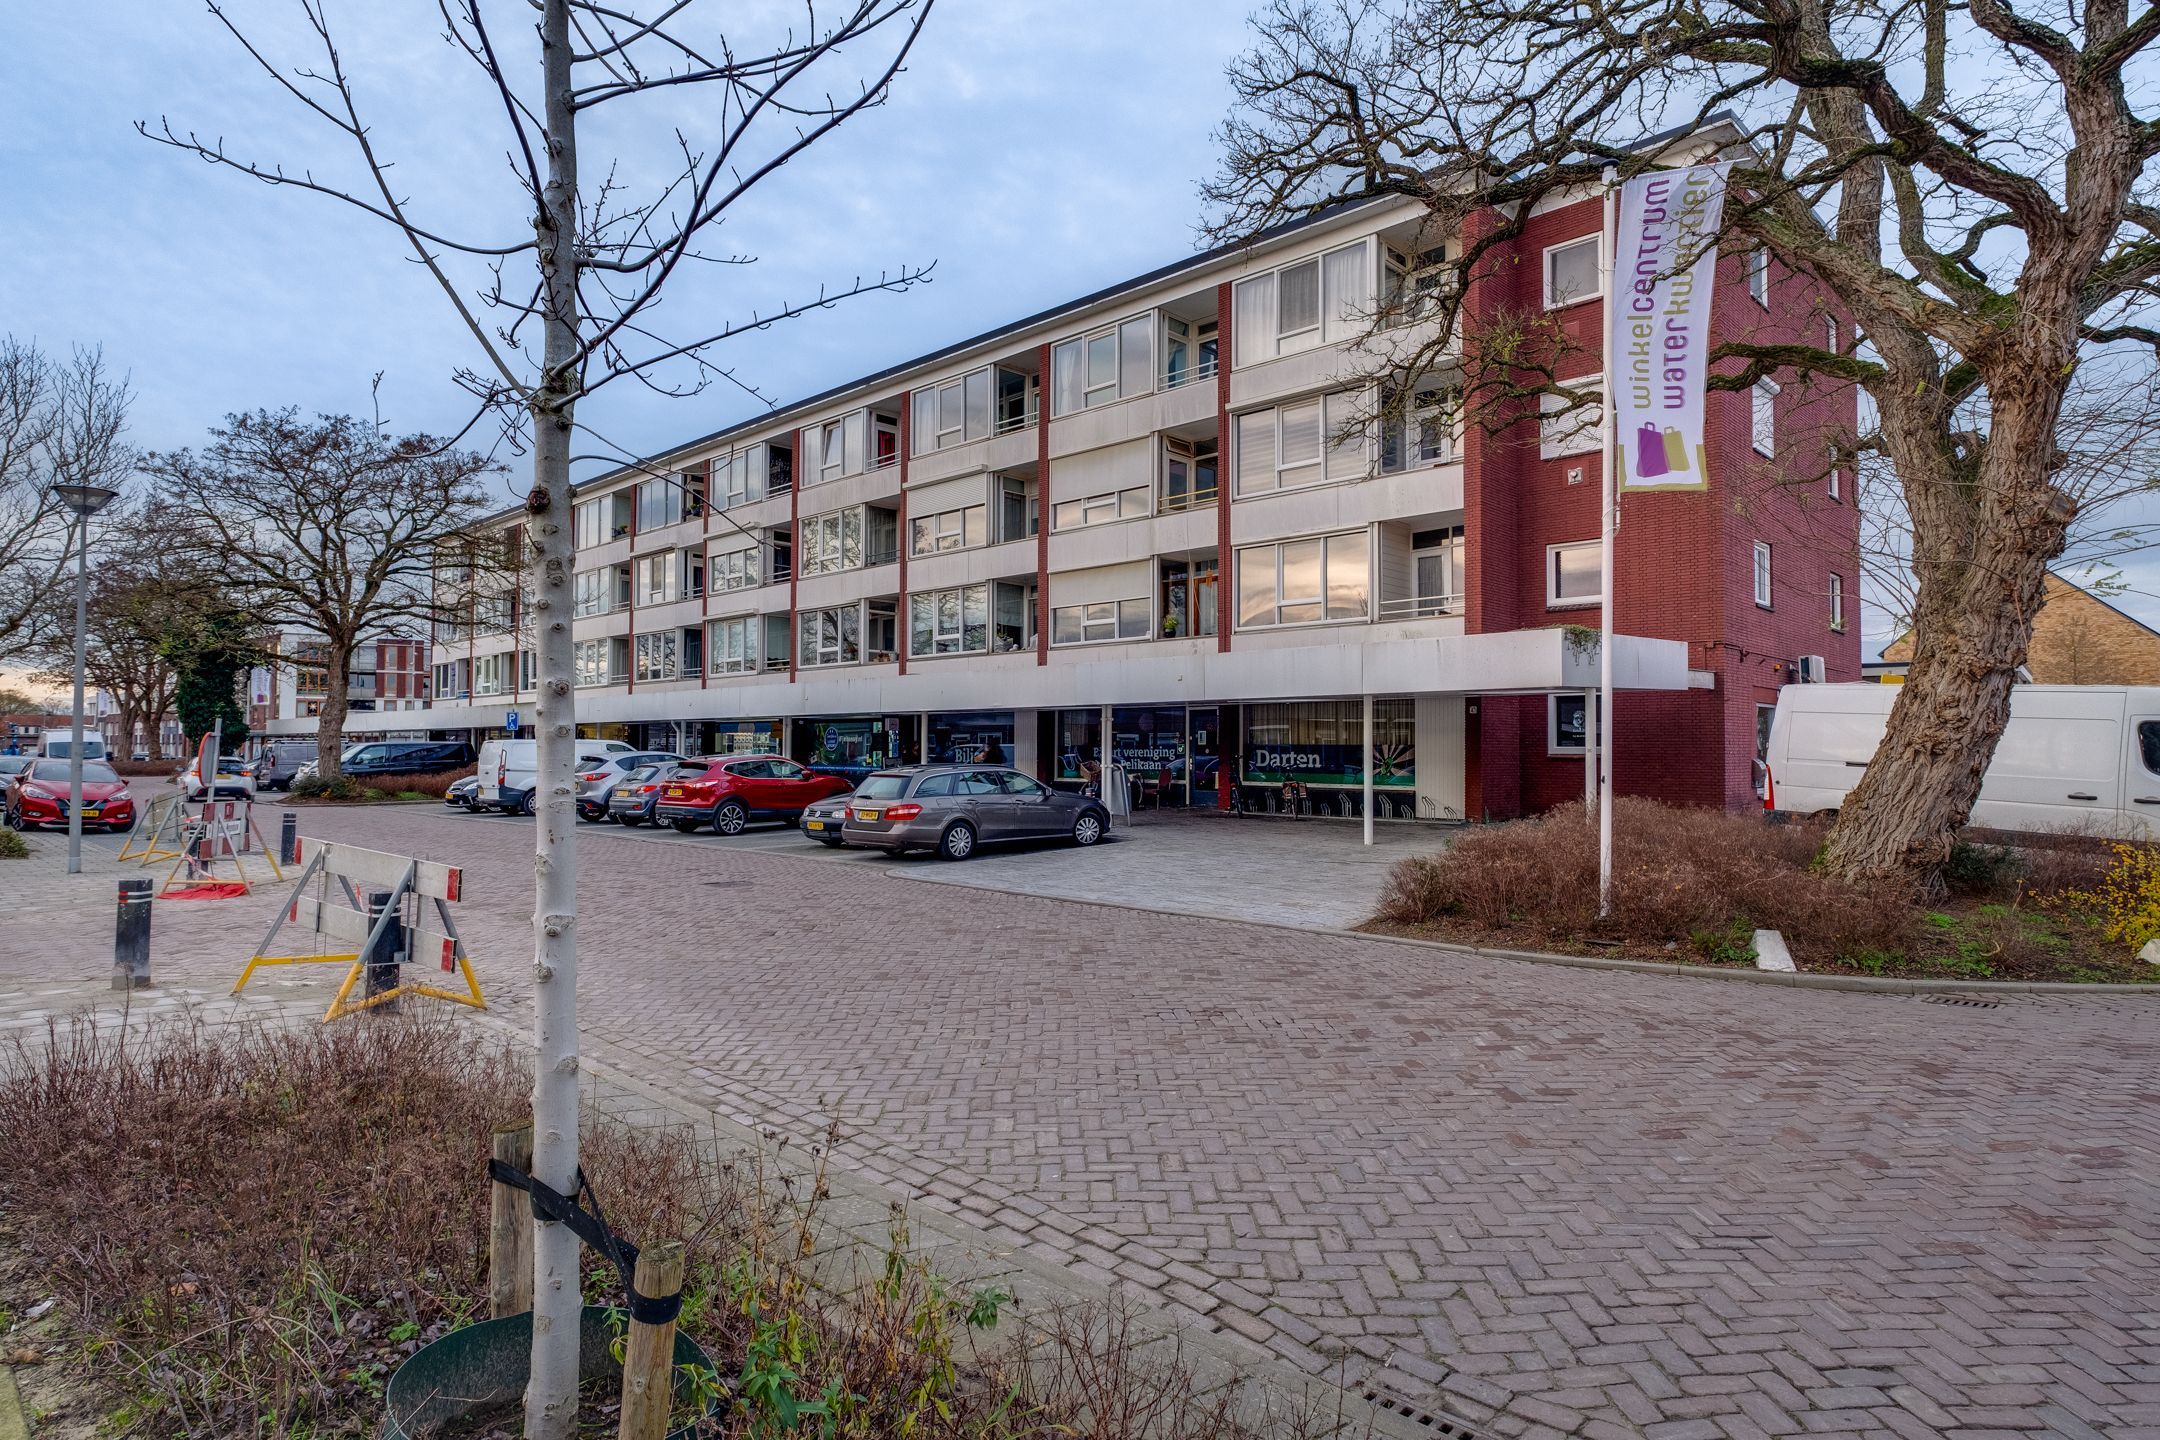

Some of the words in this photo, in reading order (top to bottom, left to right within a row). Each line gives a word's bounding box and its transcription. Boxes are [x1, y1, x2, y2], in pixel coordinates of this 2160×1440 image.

[1627, 178, 1670, 409] winkelcentrum
[1123, 746, 1176, 760] vereniging
[1256, 749, 1322, 768] Darten
[1120, 759, 1162, 770] Pelikaan
